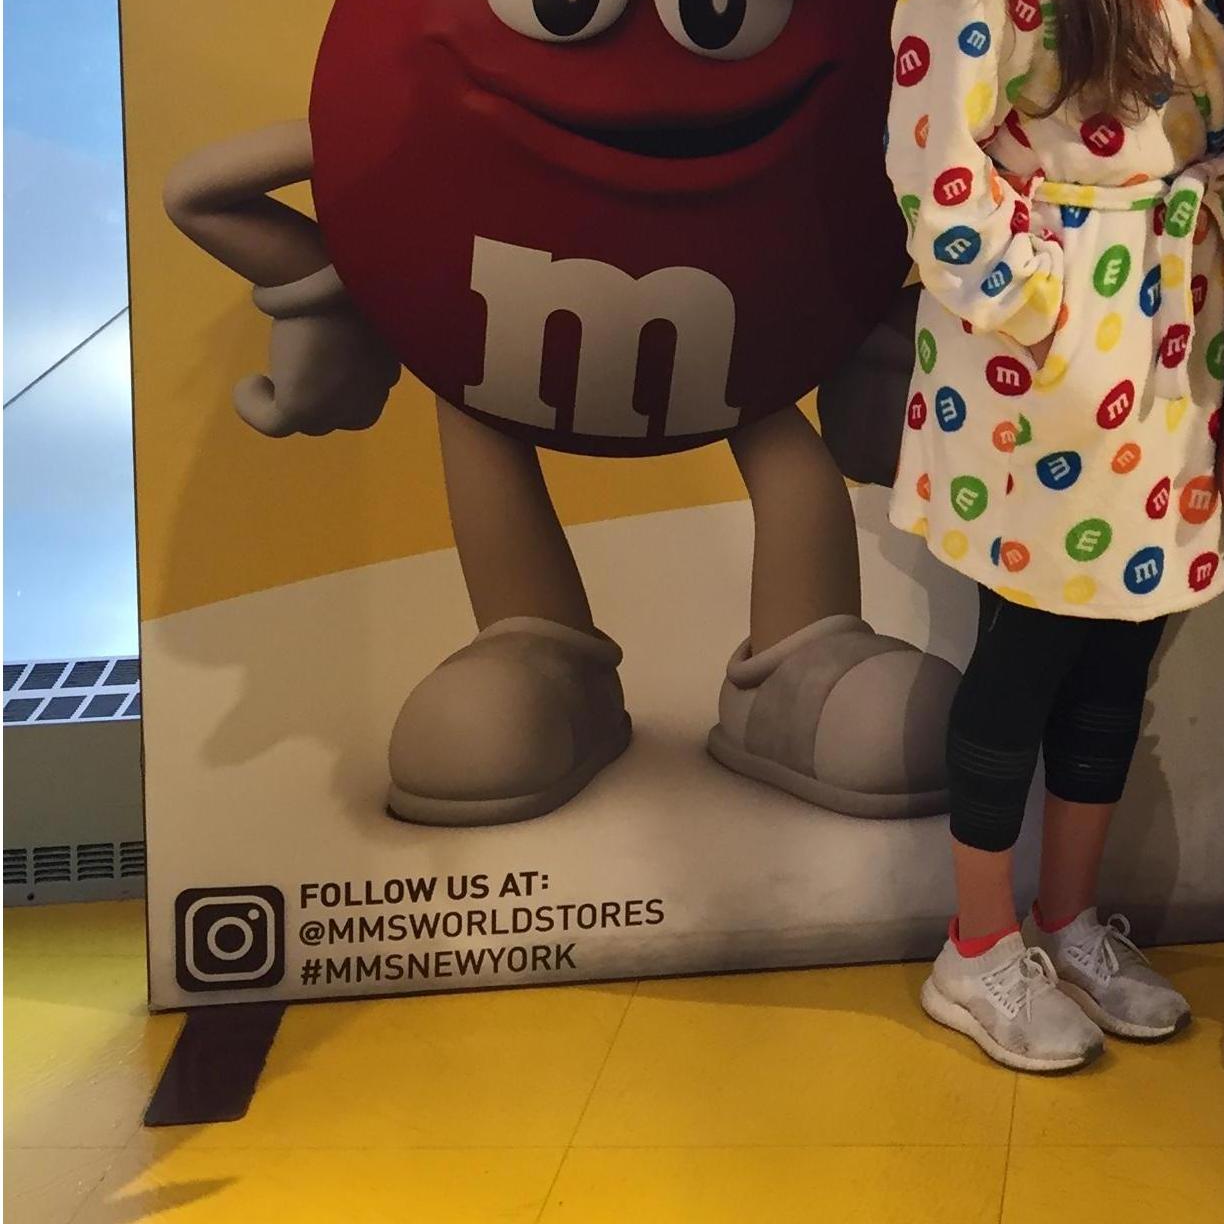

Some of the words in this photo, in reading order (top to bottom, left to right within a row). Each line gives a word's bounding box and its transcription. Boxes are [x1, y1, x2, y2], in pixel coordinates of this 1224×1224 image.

[1015, 0, 1037, 22] m
[966, 30, 986, 50] m
[900, 49, 923, 75] m
[942, 178, 967, 200] m
[464, 235, 742, 438] m
[995, 366, 1020, 387] m
[940, 396, 958, 423] m
[1107, 392, 1129, 421] m
[1047, 455, 1070, 481] m
[956, 487, 979, 512] m
[1188, 488, 1212, 510] m
[1134, 559, 1159, 584] m
[1196, 562, 1212, 582] m
[300, 877, 436, 909] FOLLOW
[447, 874, 490, 900] US
[498, 871, 549, 897] AT:
[299, 899, 665, 946] @MMSWORLDSTORES
[301, 943, 576, 986] #MMSNEWYORK
